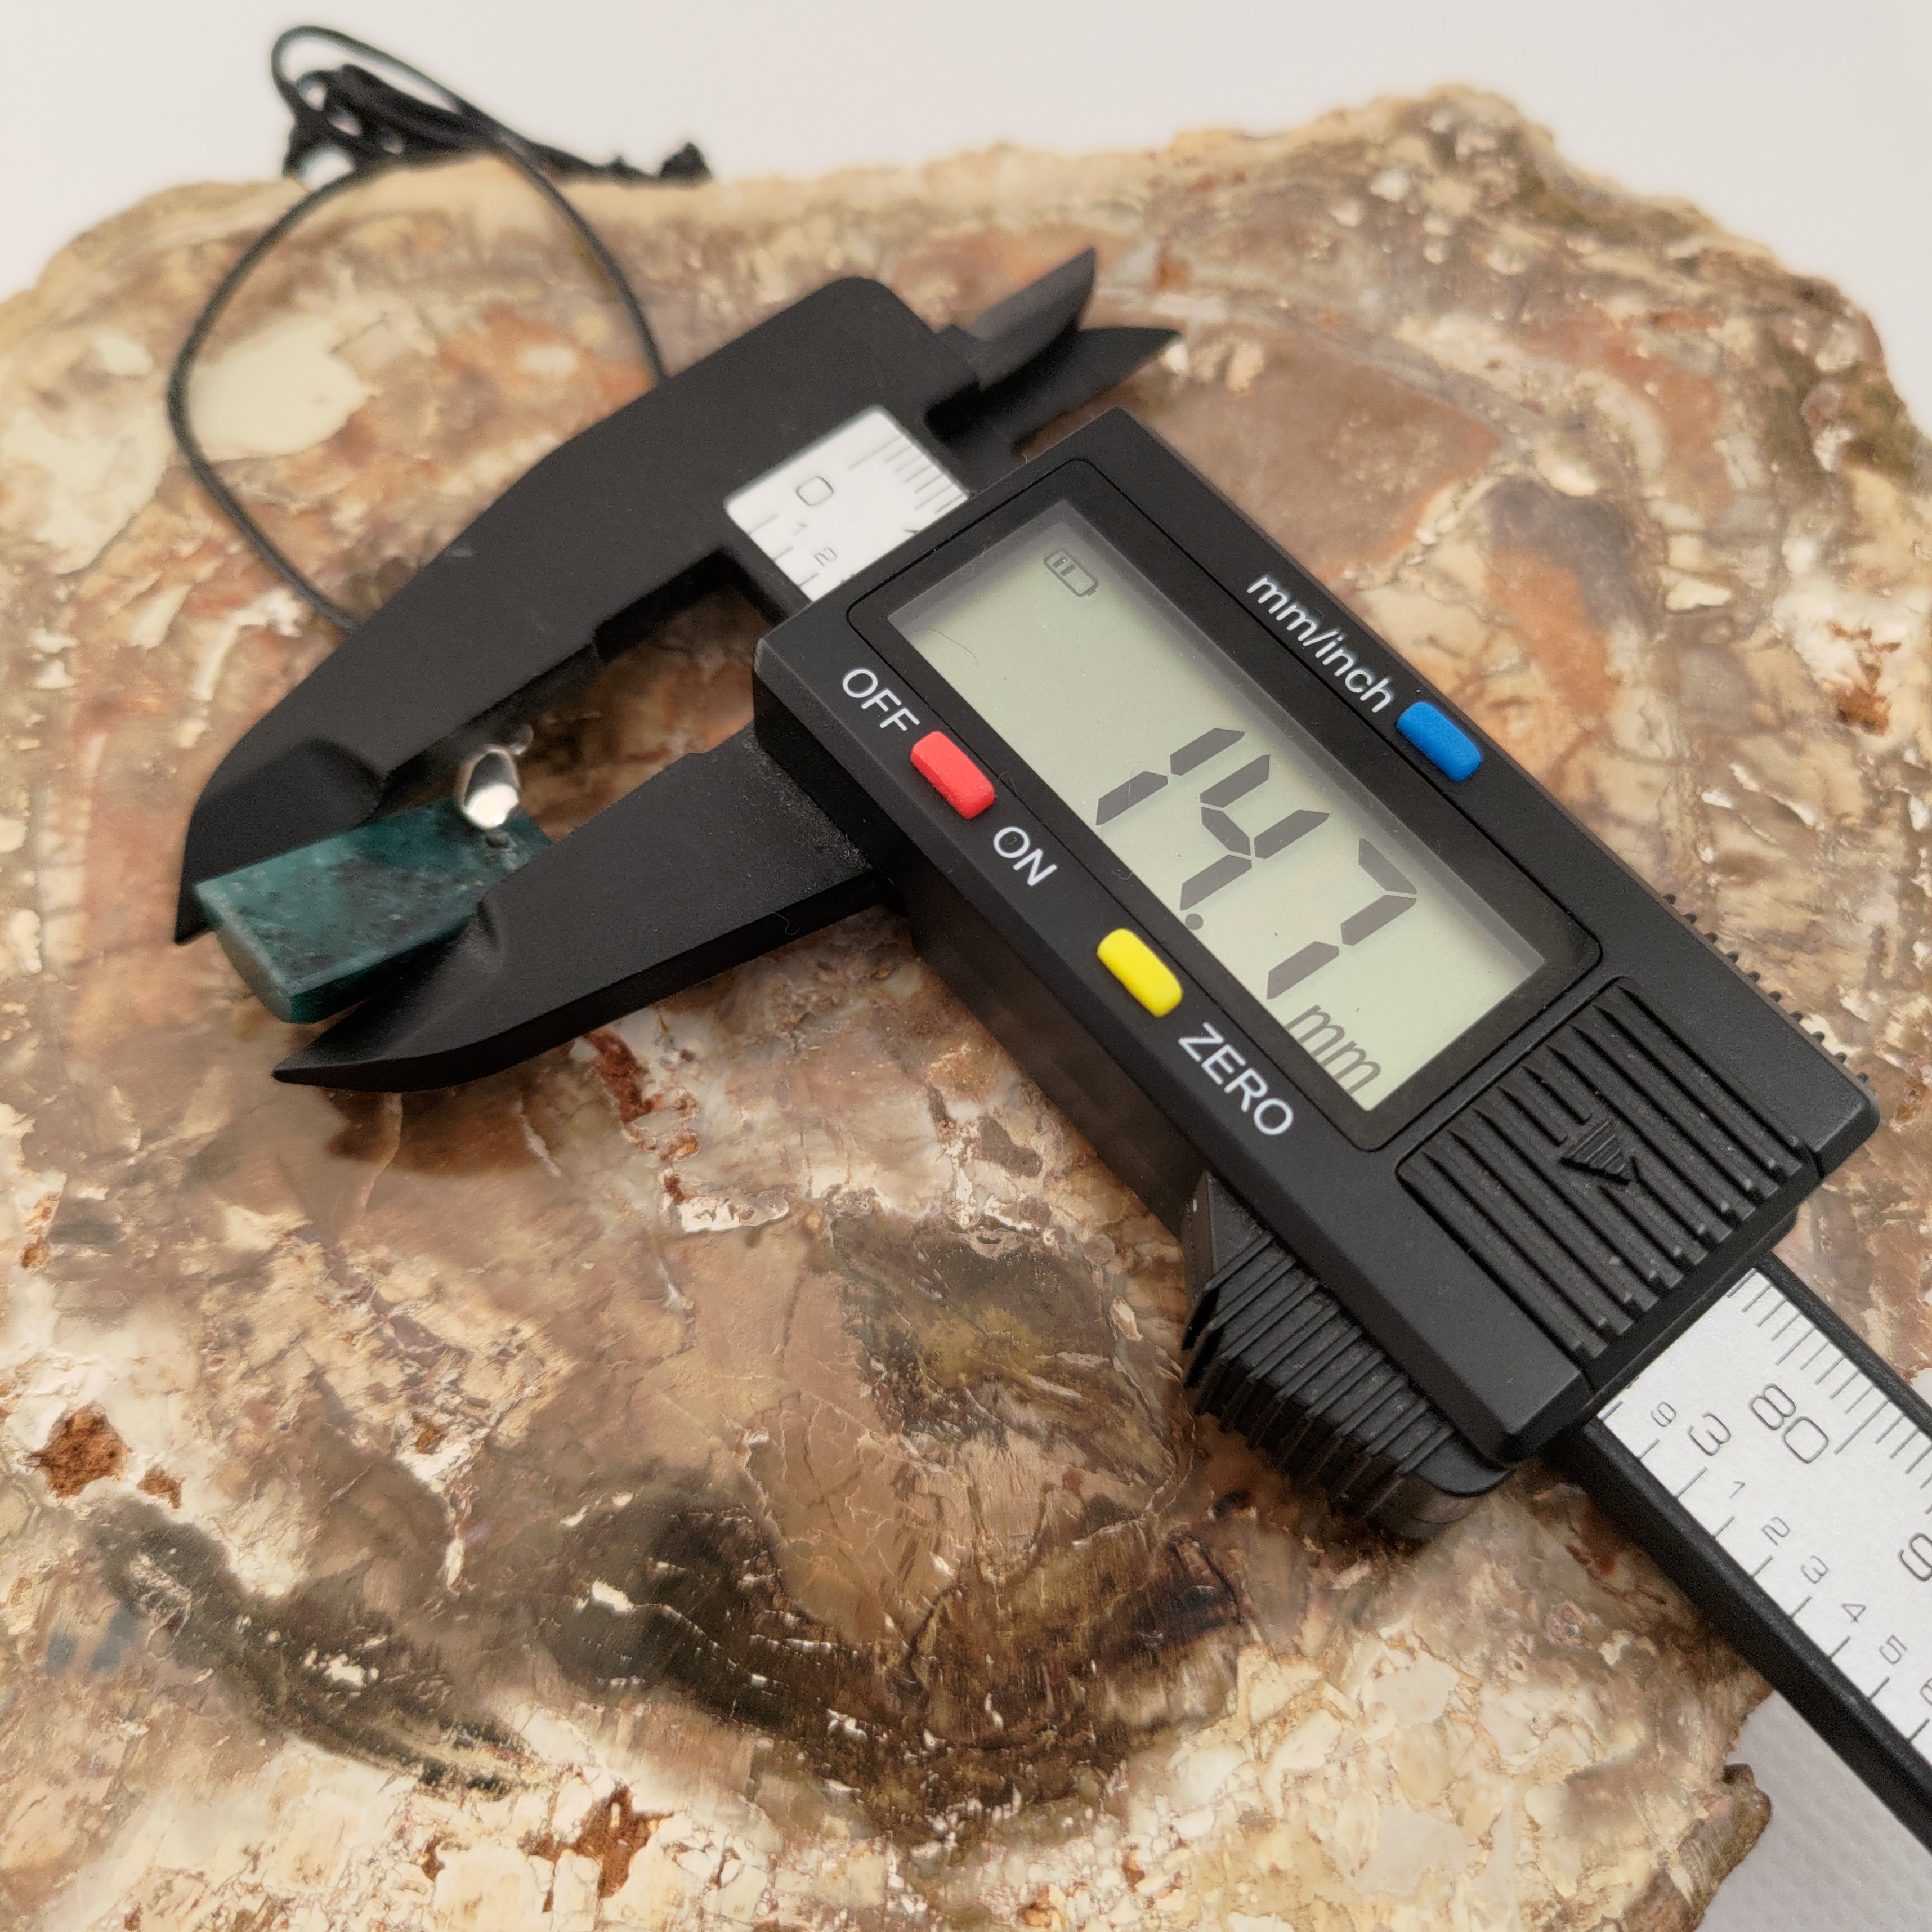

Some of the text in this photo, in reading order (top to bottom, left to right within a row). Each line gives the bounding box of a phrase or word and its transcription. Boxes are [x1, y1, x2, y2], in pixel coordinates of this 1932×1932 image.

[795, 475, 835, 507] 0
[813, 547, 838, 567] 2
[1246, 575, 1396, 713] mm/inch
[842, 668, 921, 732] OFF
[992, 826, 1058, 887] ON
[1095, 727, 1418, 1000] 14.7
[1178, 1022, 1294, 1136] ZERO
[1283, 1004, 1381, 1094] mm
[1748, 1383, 1830, 1464] 80
[1650, 1401, 1909, 1666] 9 3 1 2 3 4 5
